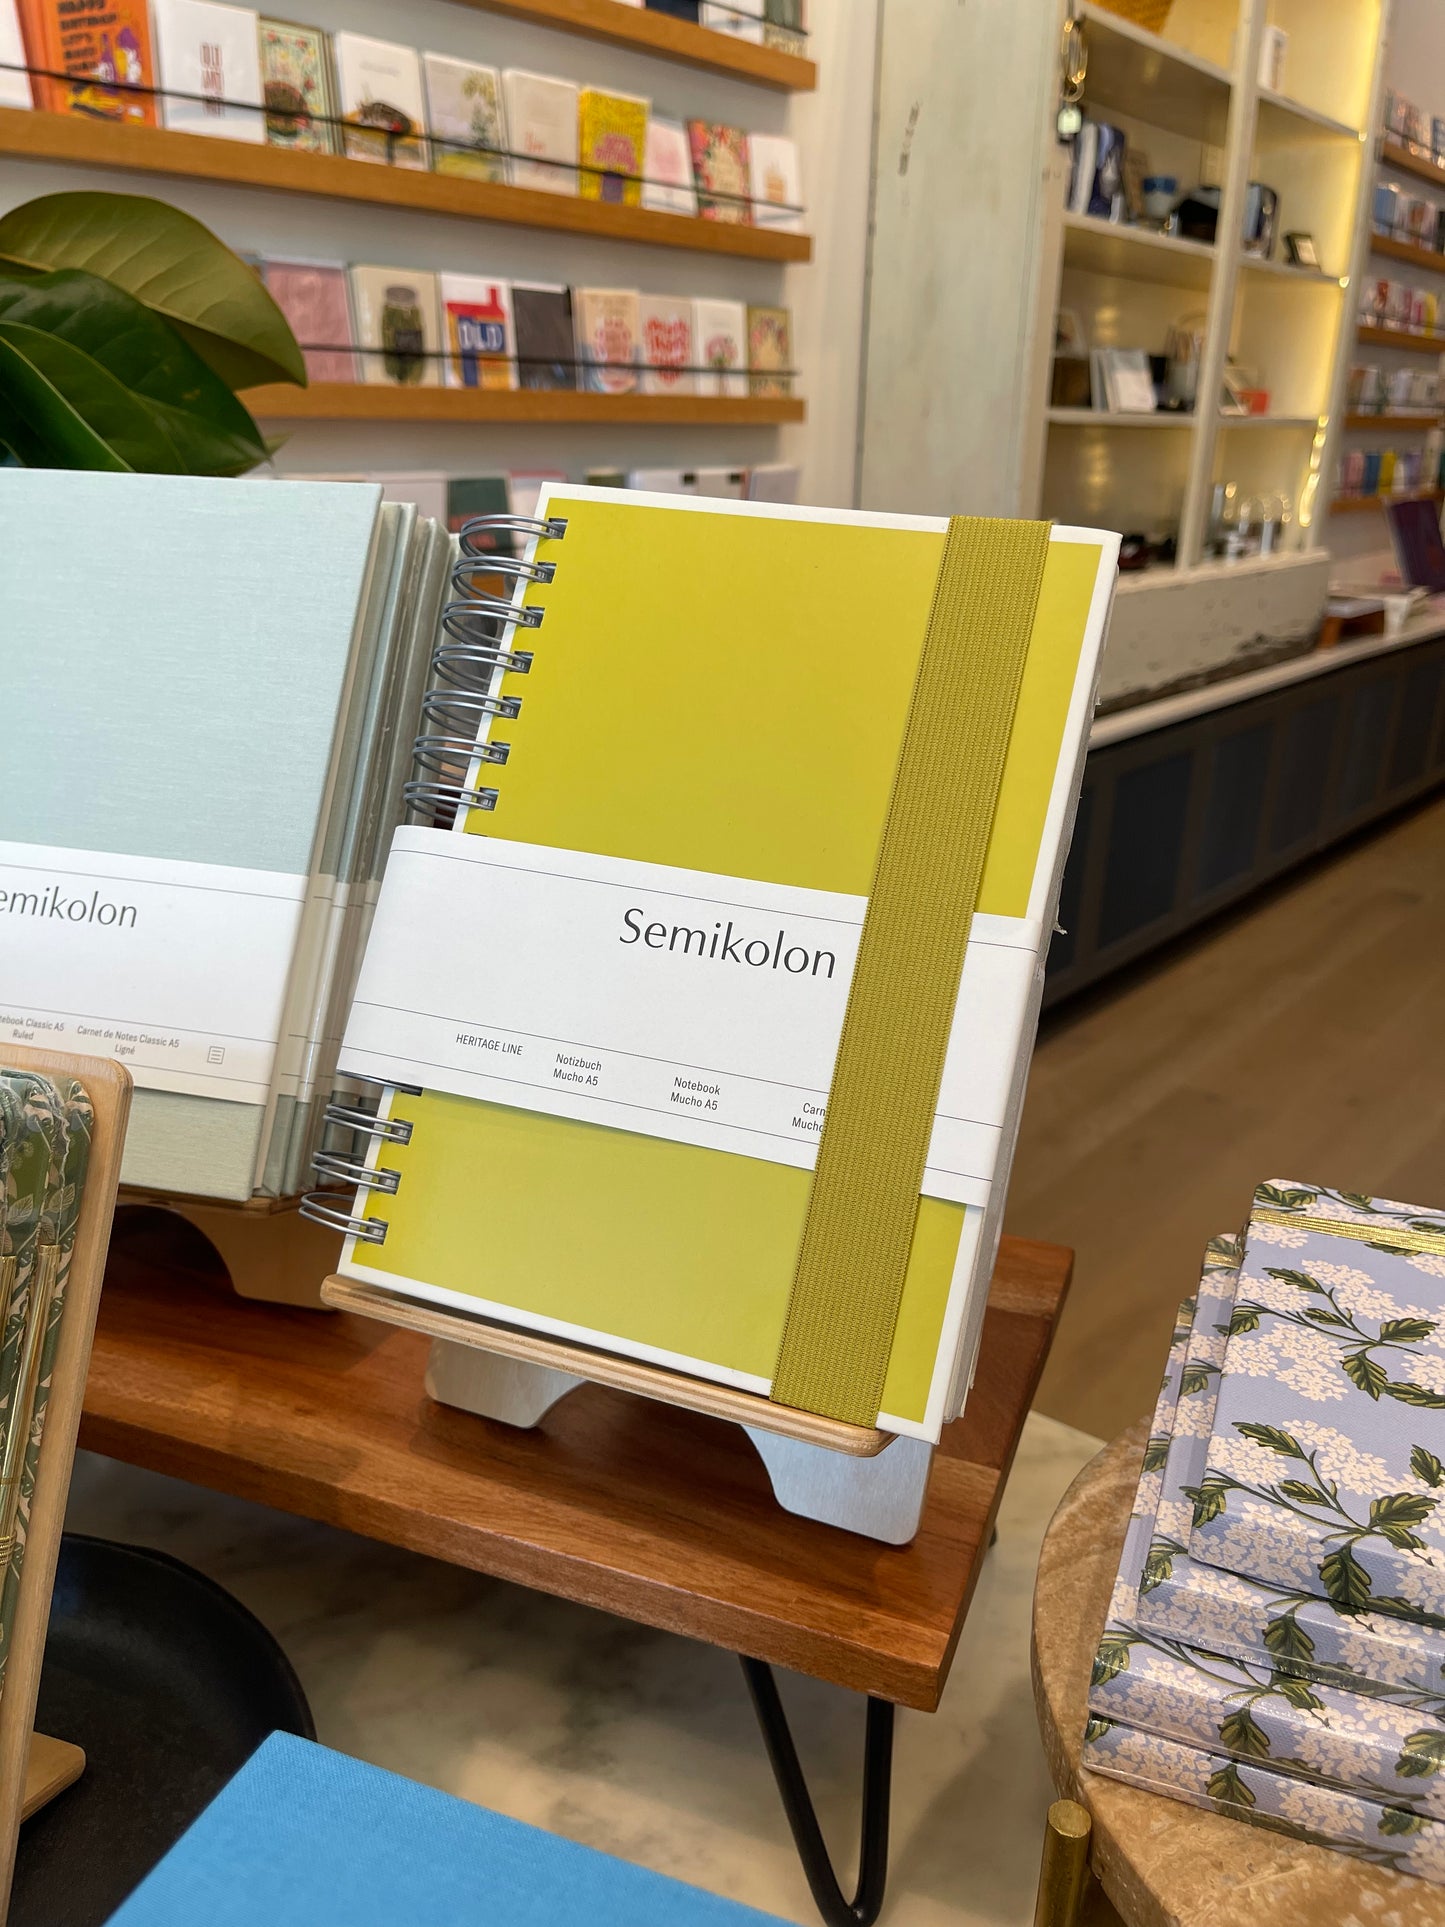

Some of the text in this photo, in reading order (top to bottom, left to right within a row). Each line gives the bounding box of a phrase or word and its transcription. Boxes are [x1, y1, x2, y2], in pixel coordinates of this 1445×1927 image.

[619, 908, 836, 979] Semikolon
[25, 1018, 53, 1030] Classic
[53, 1022, 65, 1032] A5
[12, 1029, 34, 1041] Ruled
[77, 1025, 180, 1049] Carnet de Notes Classic A5
[456, 1033, 523, 1056] HERITAGE LINE
[115, 1043, 136, 1055] Ligné
[555, 1053, 602, 1072] Notizbuch
[553, 1068, 599, 1087] Mucho A5
[674, 1076, 721, 1096] Notebook
[670, 1091, 719, 1111] Mucho A5
[802, 1102, 826, 1117] Carn
